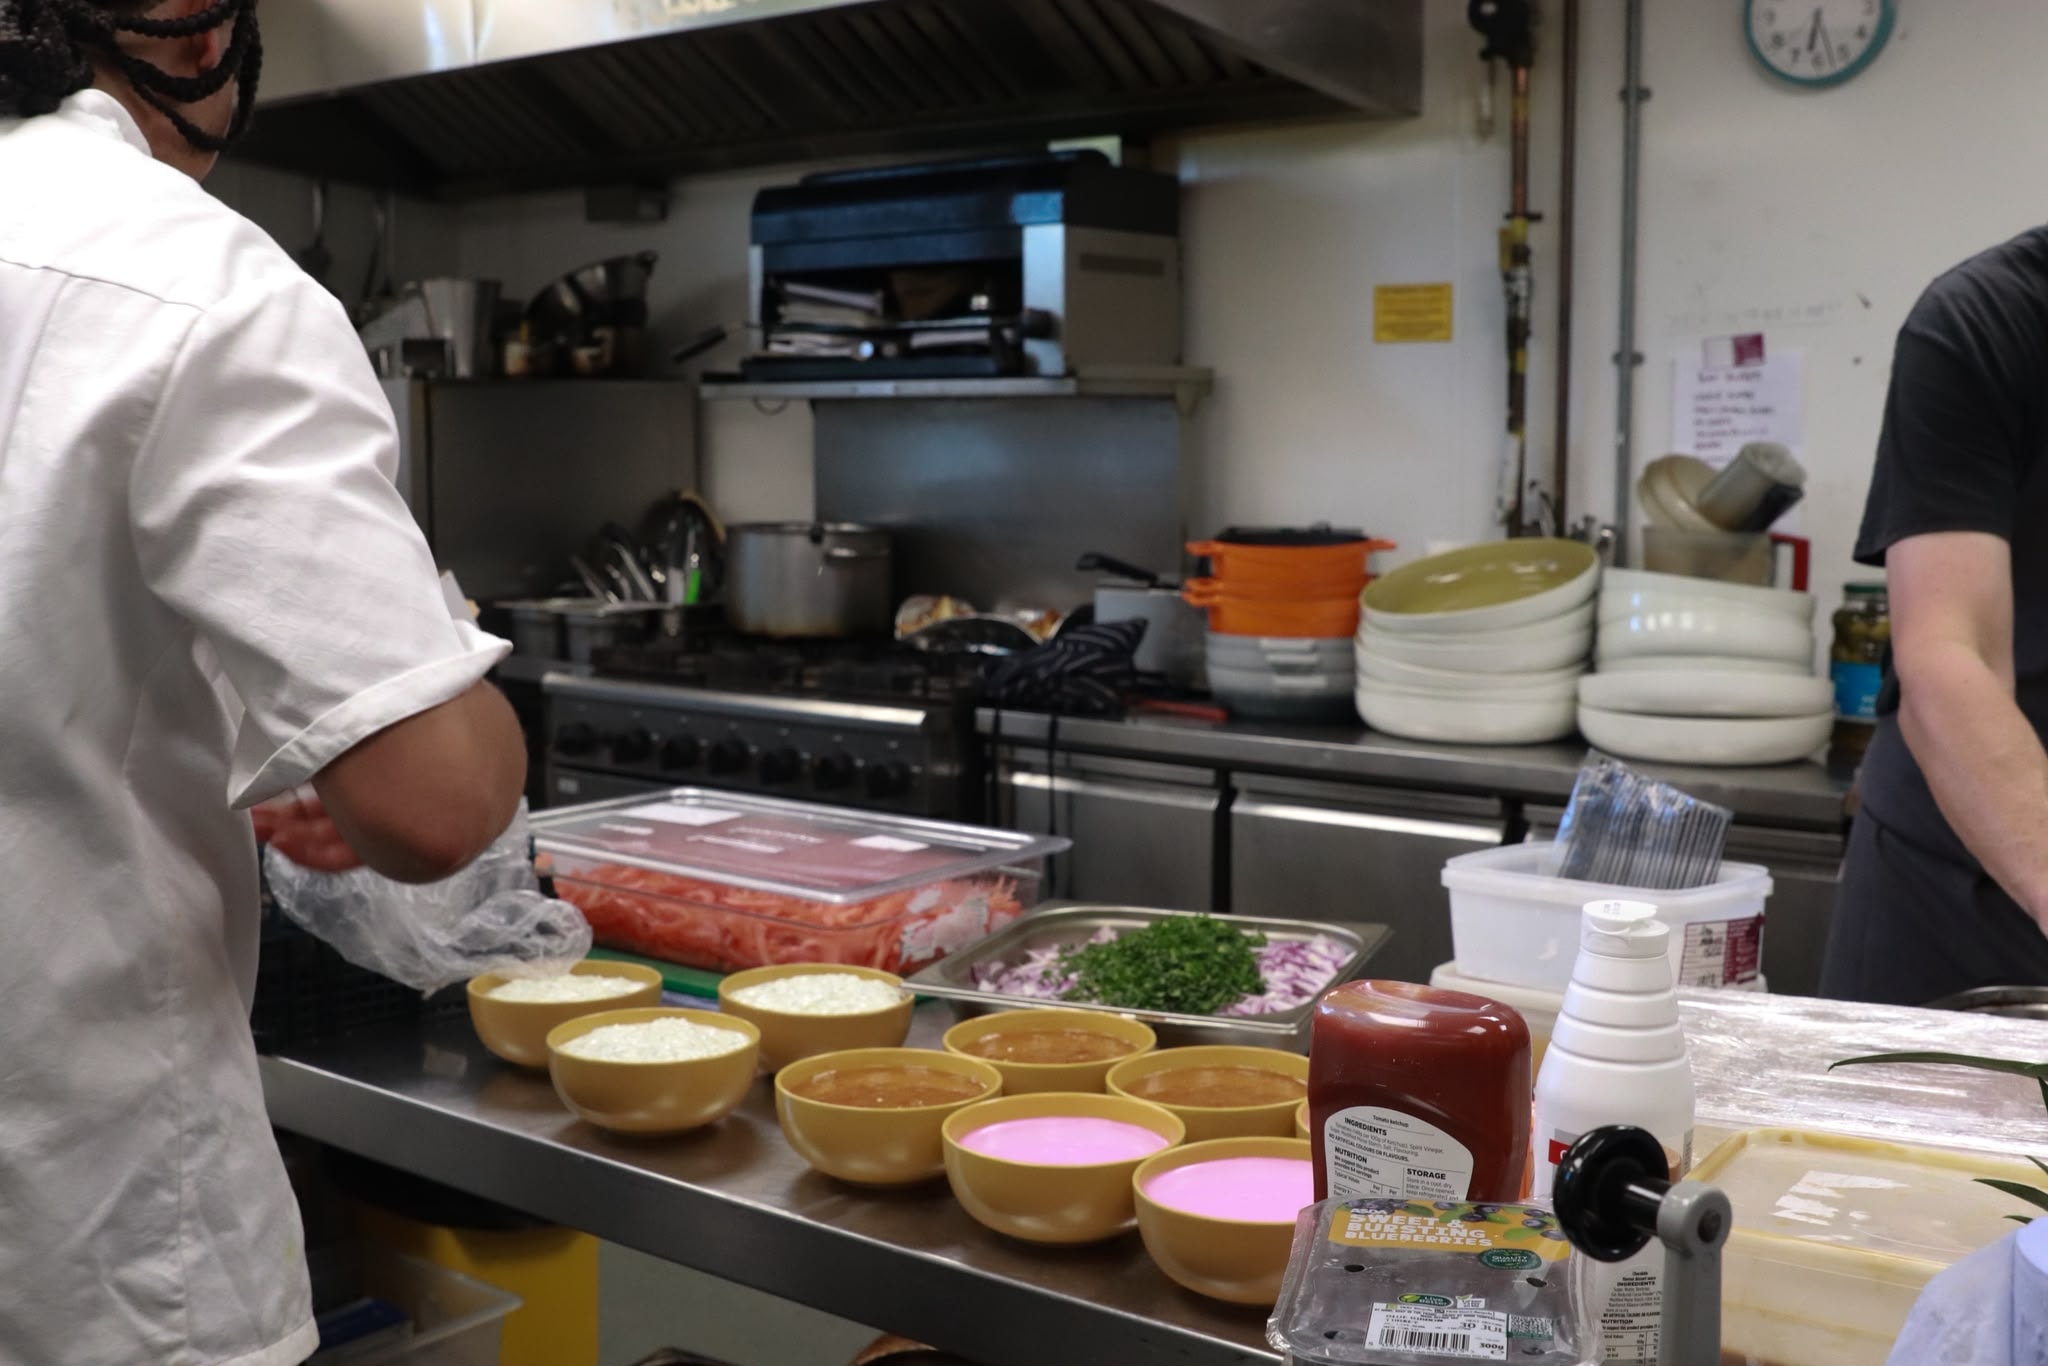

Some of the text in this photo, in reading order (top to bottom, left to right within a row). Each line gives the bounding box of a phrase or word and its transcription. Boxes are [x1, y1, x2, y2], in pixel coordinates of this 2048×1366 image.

[1344, 1116, 1387, 1136] INGREDIENTS
[1390, 1119, 1409, 1128] ketchup
[1356, 1142, 1375, 1153] COLOURS
[1334, 1146, 1368, 1164] NUTRITION
[1363, 1166, 1380, 1175] product
[1406, 1168, 1447, 1180] STORAGE
[1350, 1214, 1464, 1228] SWEET &
[1347, 1223, 1486, 1239] BURSTING
[1345, 1231, 1493, 1246] BLUEBERRIES
[1481, 1324, 1506, 1333] JUL
[1479, 1342, 1505, 1350] 300g
